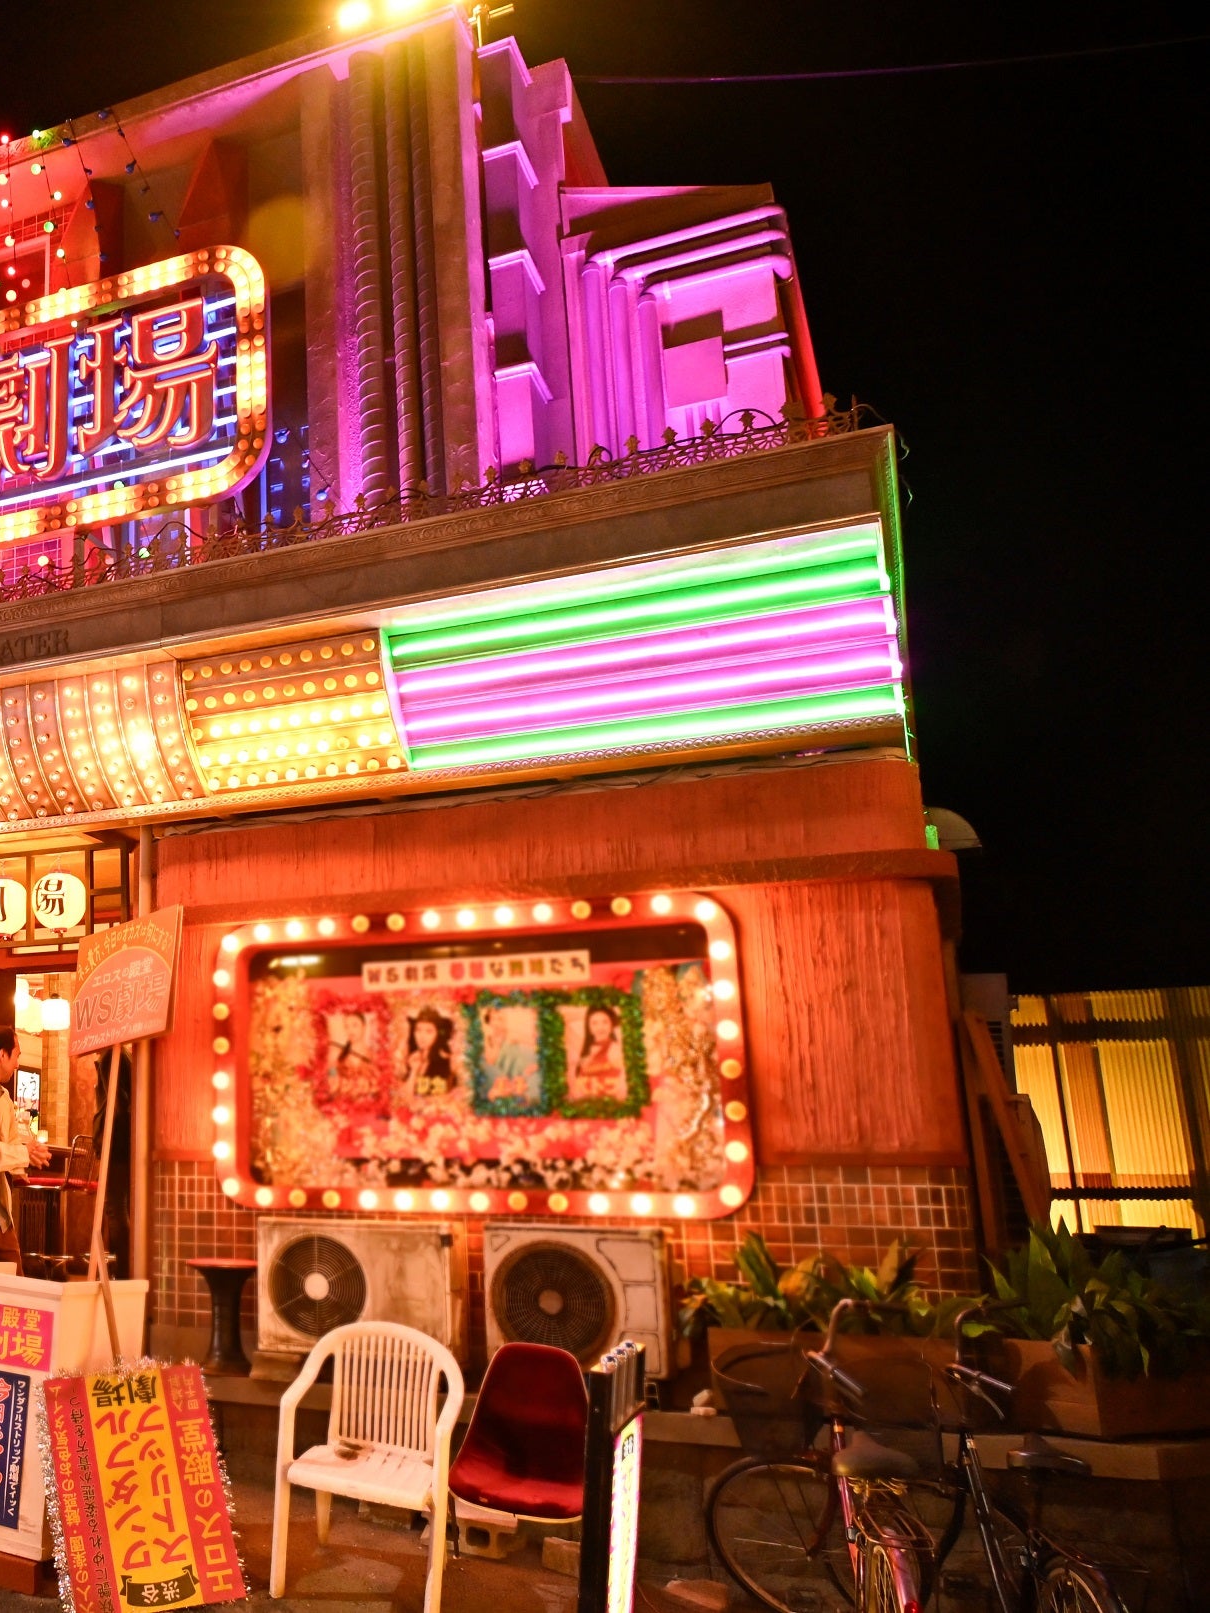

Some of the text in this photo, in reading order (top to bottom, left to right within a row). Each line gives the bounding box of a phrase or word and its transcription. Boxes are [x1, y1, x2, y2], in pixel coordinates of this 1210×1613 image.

[74, 970, 168, 1032] WS劇場
[92, 1374, 158, 1408] 劇場
[94, 1408, 152, 1571] ワンダフル
[130, 1404, 189, 1565] ストリップ
[175, 1417, 234, 1593] エロスの殿堂
[141, 1581, 180, 1603] 渋谷
